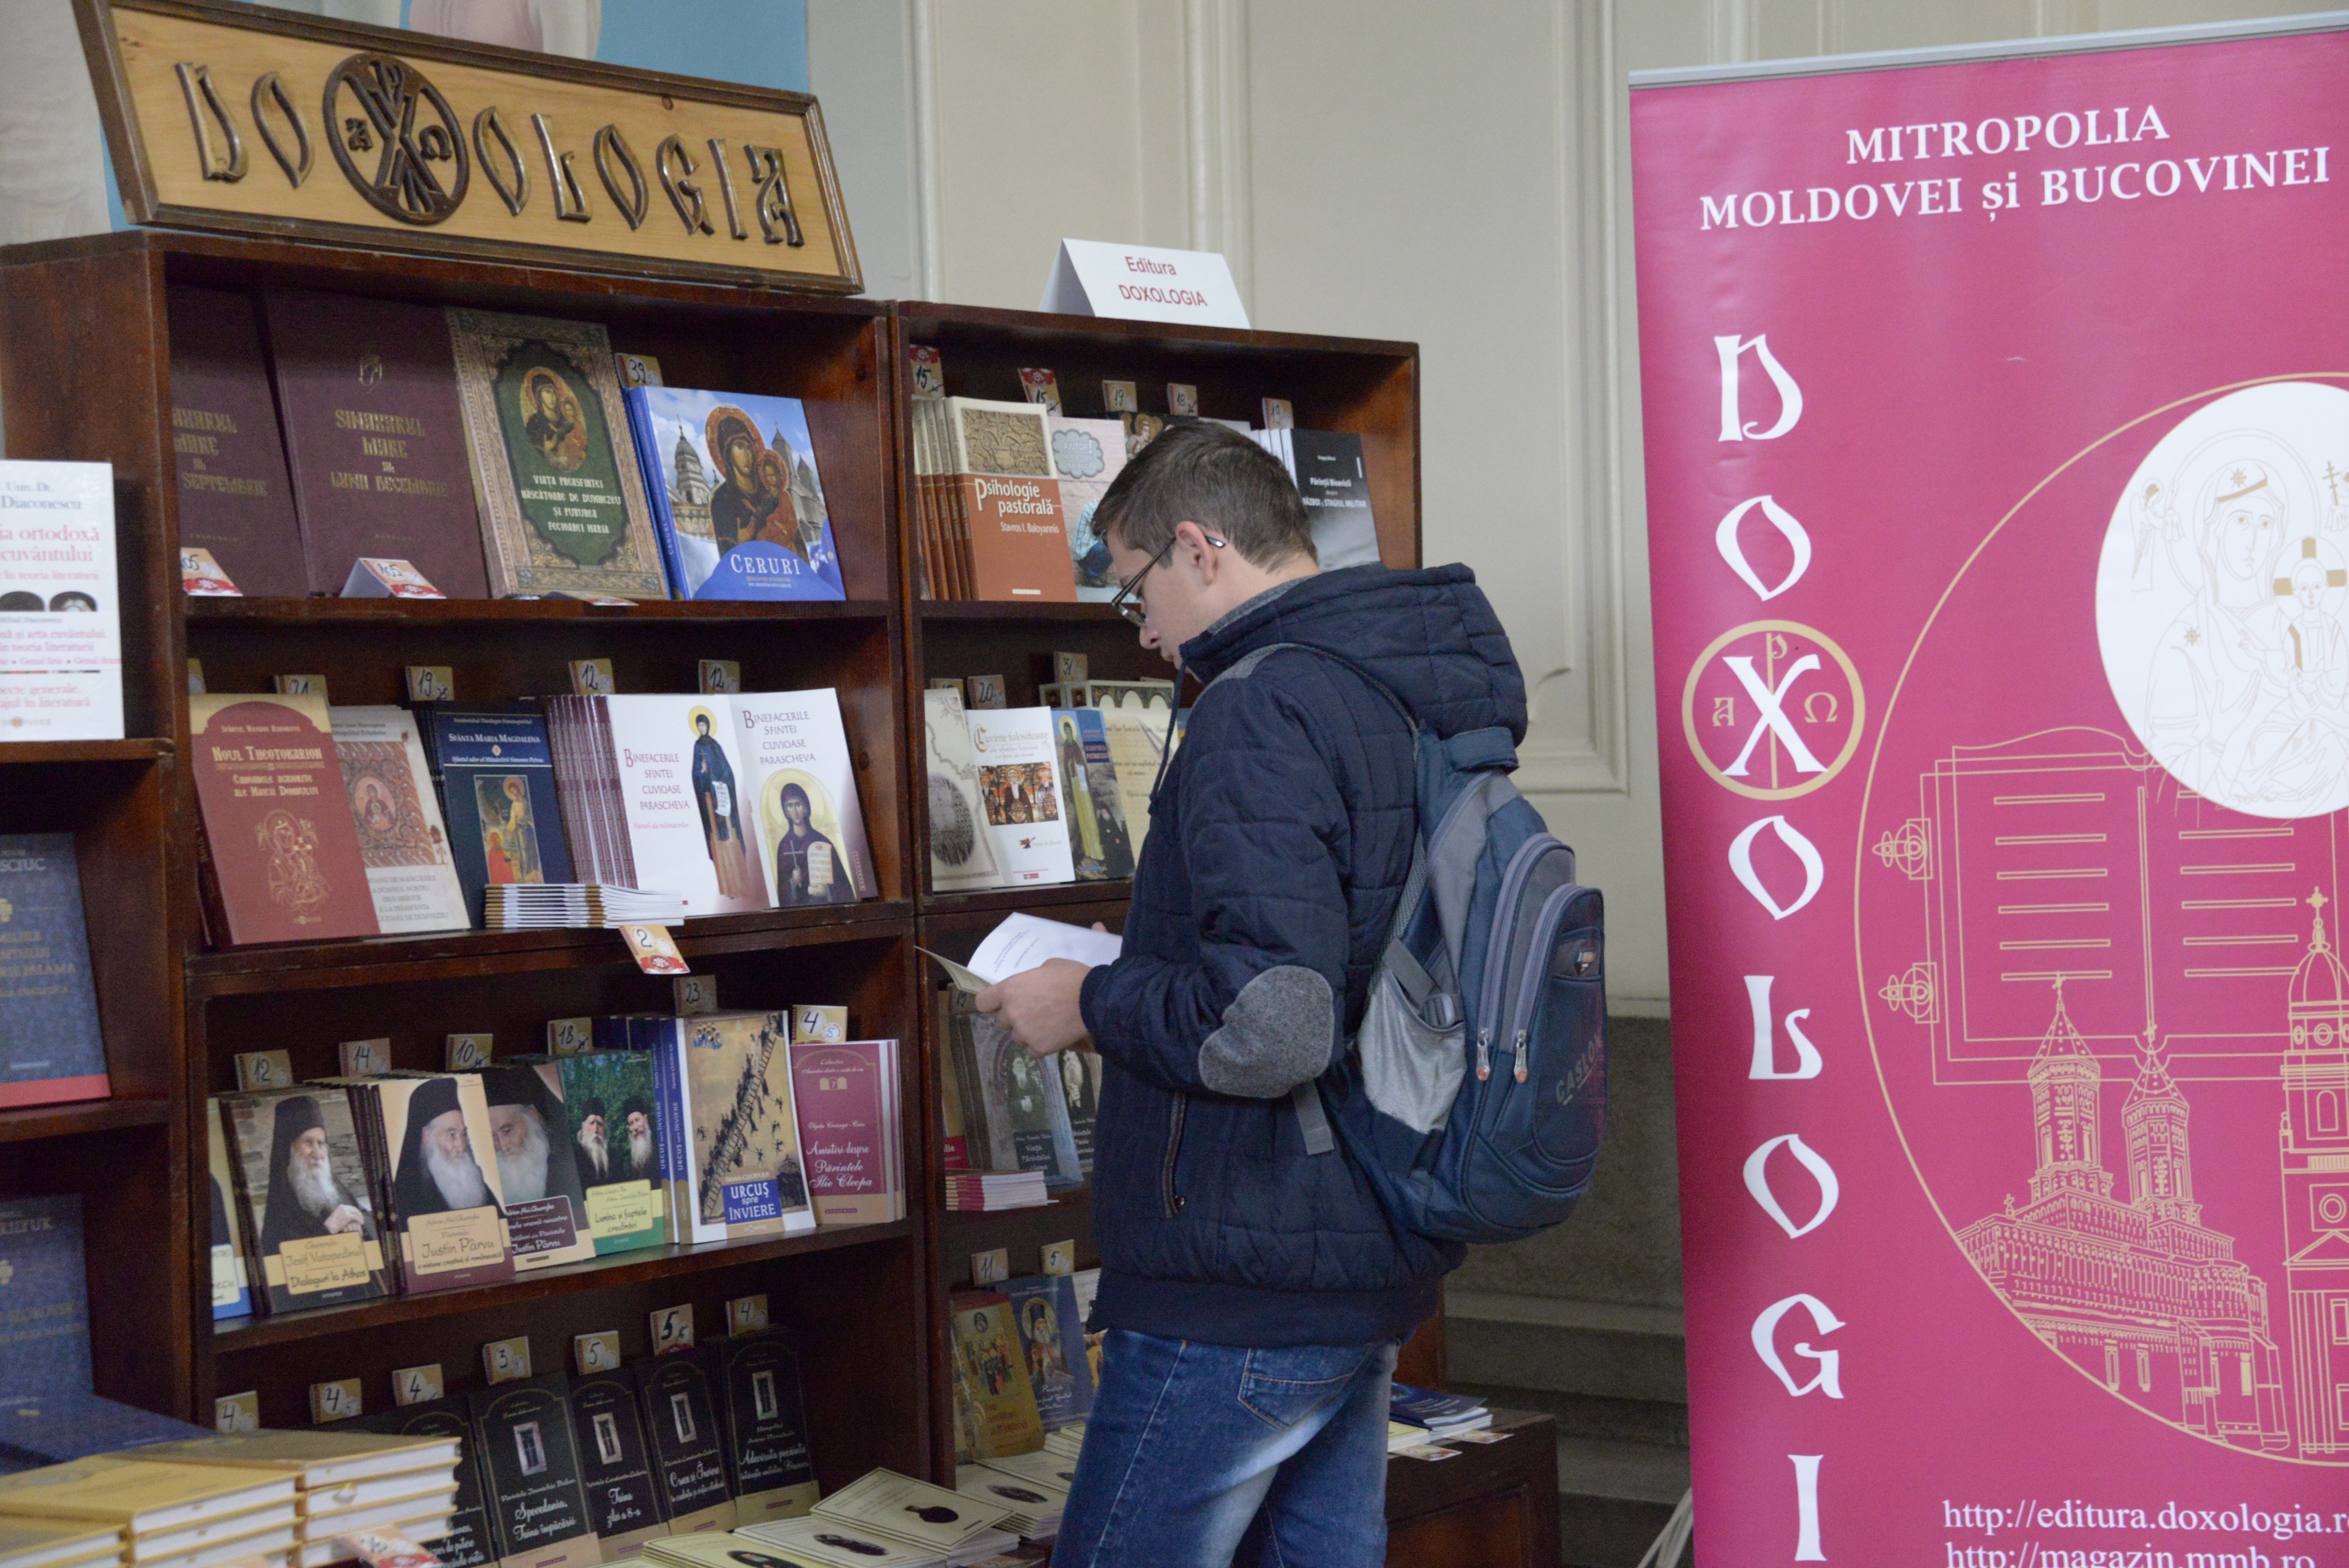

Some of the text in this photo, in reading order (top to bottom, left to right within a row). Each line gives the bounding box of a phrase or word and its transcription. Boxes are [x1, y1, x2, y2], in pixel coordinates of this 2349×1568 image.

[1845, 104, 2169, 165] MITROPOLIA
[1699, 146, 2330, 231] MOLDOVEI și BUCOVINEI
[1125, 256, 1176, 275] Editura
[1119, 285, 1208, 306] DOXOLOGIA
[627, 358, 645, 383] 39
[916, 365, 931, 390] 15
[1, 495, 81, 509] Diaconescu
[975, 478, 1041, 511] Psihologie
[998, 498, 1054, 518] pastorală
[19, 524, 100, 541] ortodoxă
[586, 524, 610, 534] MARIA
[1000, 522, 1022, 533] Stavros
[1027, 523, 1060, 536] Baloyannis
[1, 545, 93, 561] cuvântului
[730, 553, 801, 575] CERURI
[417, 670, 434, 697] 19
[581, 664, 599, 690] 12
[709, 666, 724, 690] 12
[742, 710, 810, 729] BINEFACERILE
[764, 725, 797, 735] SFINTEI
[762, 739, 807, 750] CUVIOASE
[624, 748, 680, 768] BINEFACERILE
[759, 753, 816, 765] PARASCHEVA
[645, 769, 673, 779] SFINTEI
[642, 785, 682, 794] CUVIOASE
[640, 800, 690, 810] PARASCHEVA
[636, 928, 652, 948] 2
[686, 982, 700, 1004] 23
[804, 1011, 819, 1034] 4
[558, 1024, 574, 1044] 18
[353, 1045, 370, 1070] 14
[455, 1039, 475, 1063] 10
[253, 1058, 271, 1082] 12
[806, 1140, 870, 1158] Amintiri despre
[814, 1159, 864, 1173] Părintele
[731, 1182, 769, 1199] URCUȘ
[809, 1173, 873, 1191] Ilie Cleopa
[742, 1196, 759, 1206] spre
[729, 1203, 776, 1221] ÎNVIERE
[740, 1302, 752, 1322] 4
[499, 1349, 508, 1369] 3
[589, 1341, 601, 1365] 5
[410, 1374, 421, 1401] 4
[326, 1387, 340, 1412] 4
[222, 1407, 236, 1430] 4
[1943, 1500, 2349, 1540] http://editura.doxologia.r
